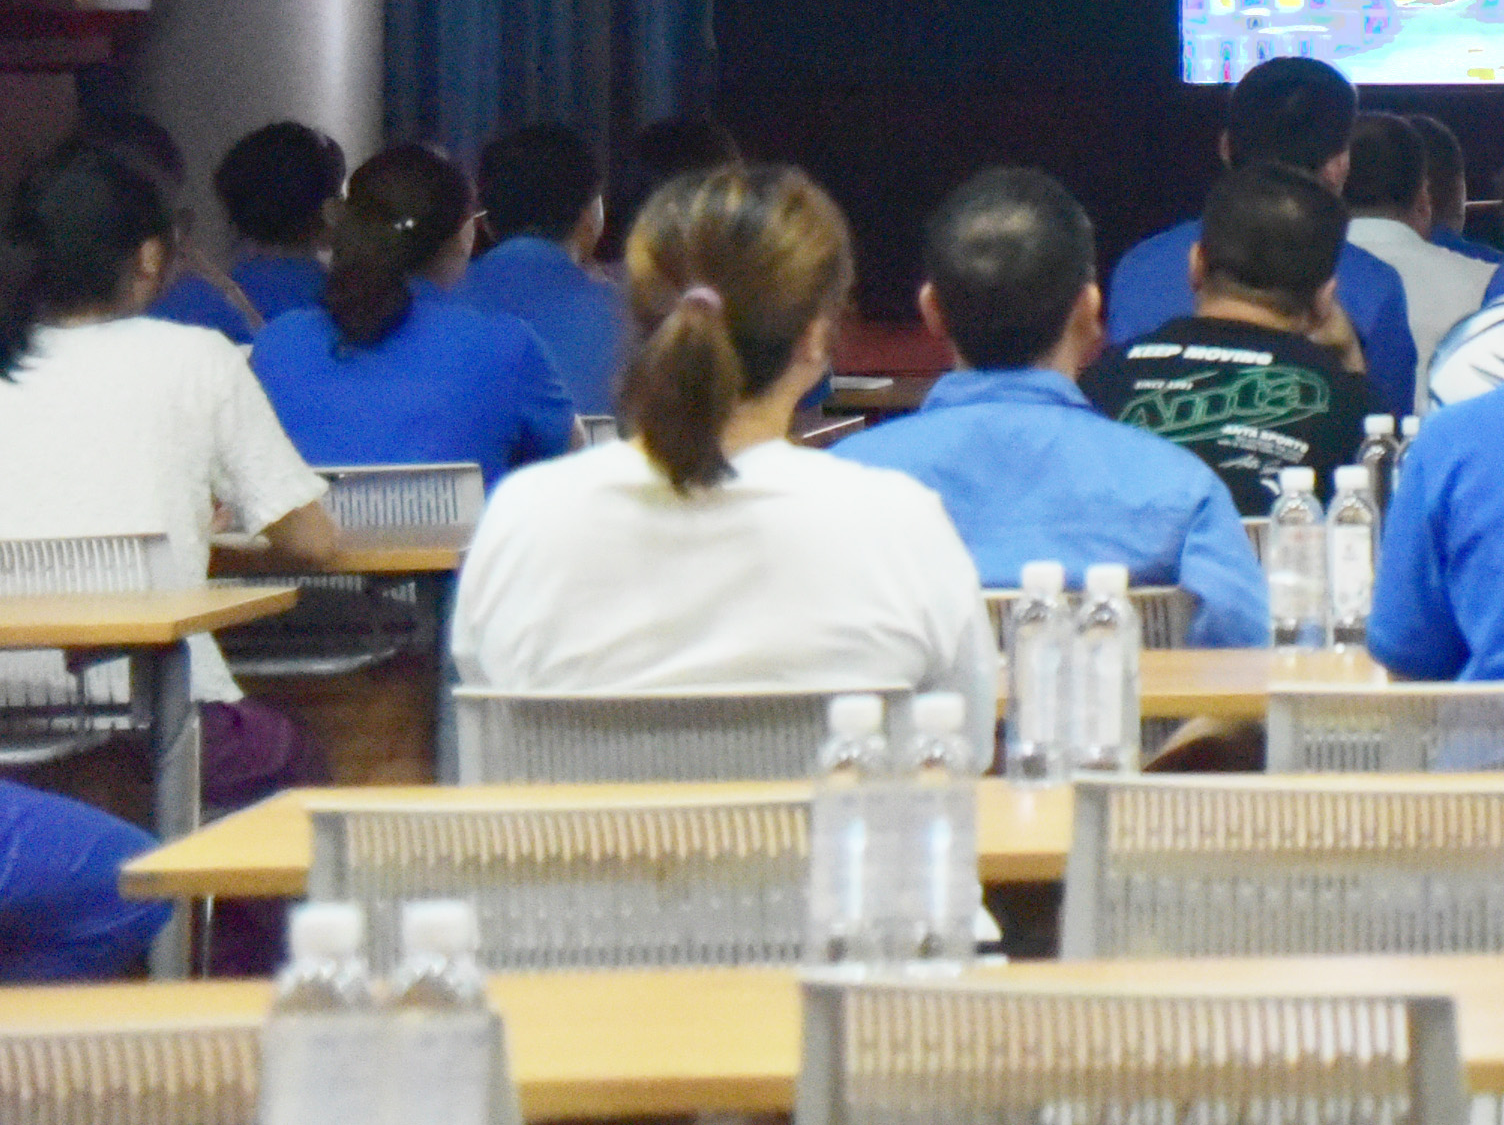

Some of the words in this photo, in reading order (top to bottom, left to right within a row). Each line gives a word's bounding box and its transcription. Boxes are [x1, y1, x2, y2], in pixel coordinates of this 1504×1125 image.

[1127, 343, 1183, 359] KEEP
[1183, 345, 1274, 366] MOVING
[1259, 430, 1310, 454] SPORTS
